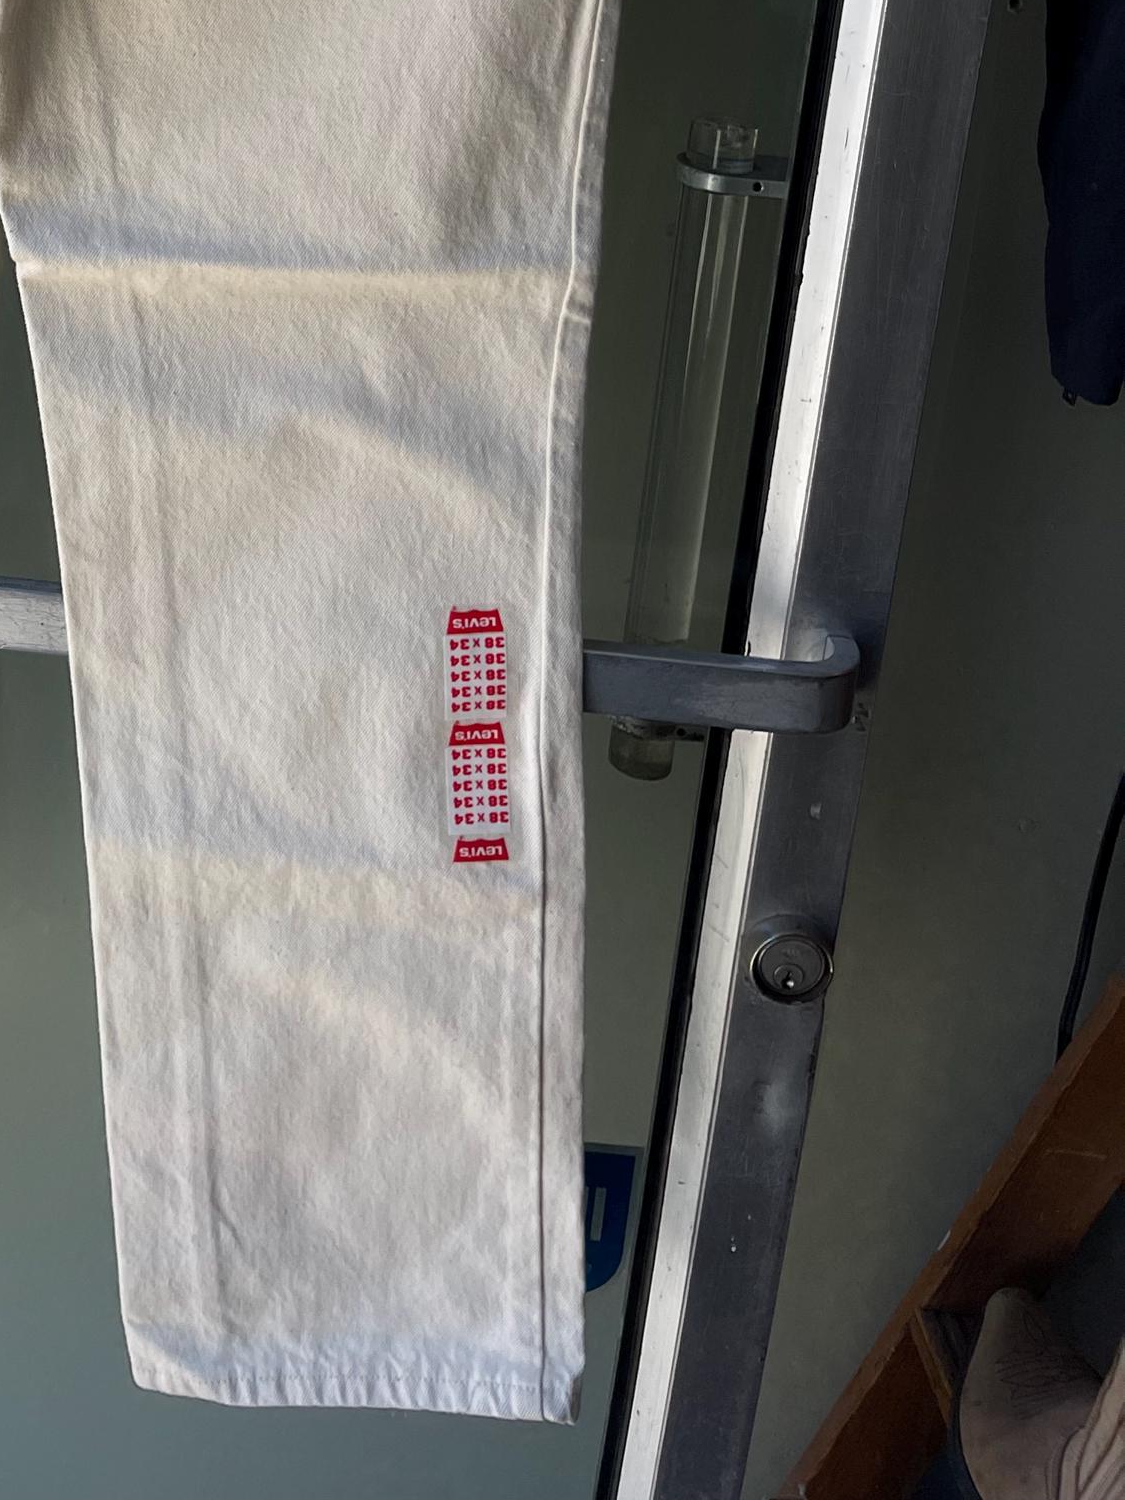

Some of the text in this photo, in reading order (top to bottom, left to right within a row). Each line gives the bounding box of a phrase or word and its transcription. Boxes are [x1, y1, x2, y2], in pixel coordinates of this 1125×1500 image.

[450, 639, 470, 651] 34
[484, 637, 505, 648] 38
[450, 655, 471, 667] 34
[485, 653, 505, 665] 38
[451, 671, 471, 682] 34
[486, 669, 506, 680] 38
[451, 686, 471, 698] 34
[486, 685, 506, 696] 38
[451, 702, 471, 713] 34
[486, 699, 506, 710] 38
[452, 749, 471, 760] 34
[487, 748, 506, 759] 38
[452, 764, 472, 776] 34
[487, 763, 507, 774] 38
[453, 781, 472, 792] 34
[488, 779, 507, 790] 38
[453, 797, 473, 808] 34
[488, 795, 508, 806] 38
[454, 813, 474, 825] 34
[489, 811, 508, 823] 38
